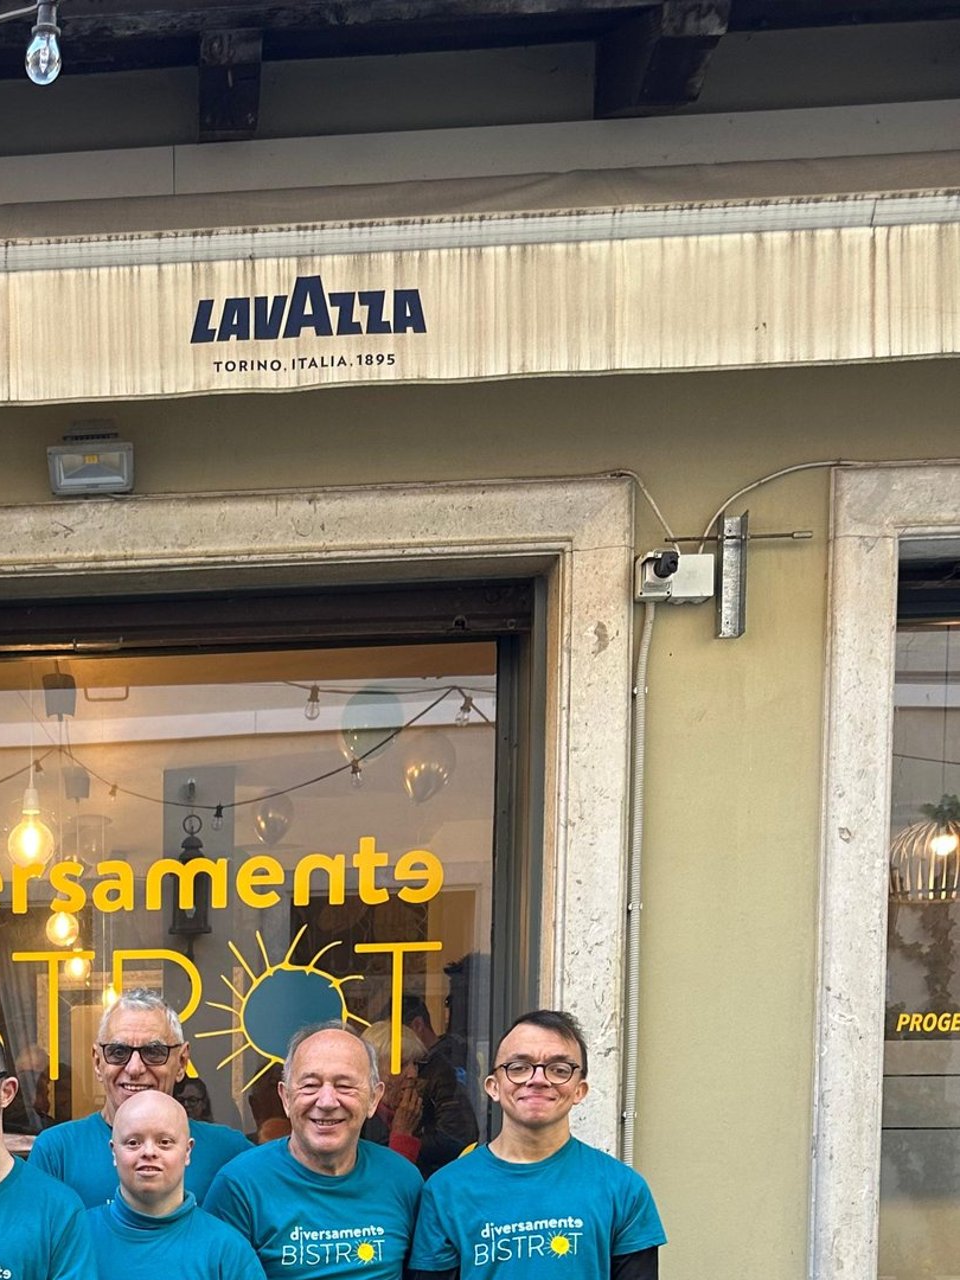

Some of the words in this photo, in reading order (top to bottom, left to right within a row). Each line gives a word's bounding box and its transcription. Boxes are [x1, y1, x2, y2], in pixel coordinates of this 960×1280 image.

[190, 275, 427, 344] LAVAZZA
[356, 353, 396, 366] 1895
[290, 1224, 385, 1242] diversamente
[481, 1215, 583, 1241] diversamente
[281, 1239, 386, 1266] BISTROT
[474, 1232, 584, 1267] BISTROT
